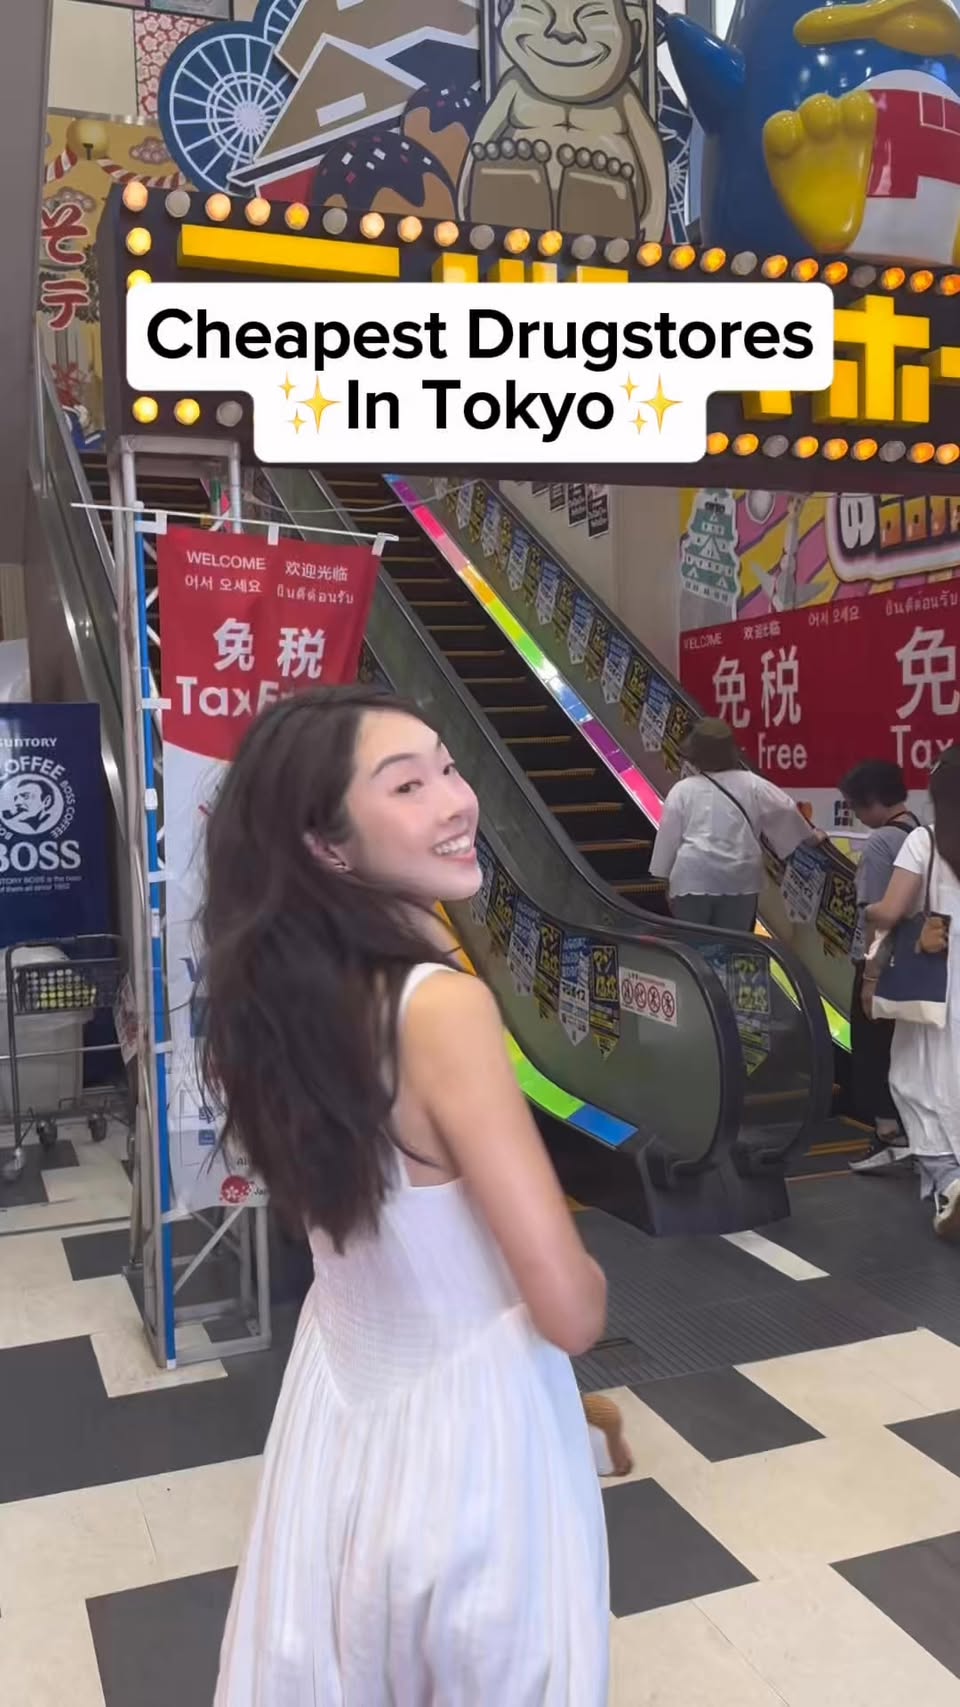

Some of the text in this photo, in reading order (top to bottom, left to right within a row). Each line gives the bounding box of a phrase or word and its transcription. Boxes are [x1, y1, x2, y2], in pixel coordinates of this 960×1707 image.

[186, 550, 267, 571] WELCOME
[284, 560, 349, 583] 欢迎光临
[184, 573, 263, 594] 어서 오세요
[757, 731, 808, 770] Free
